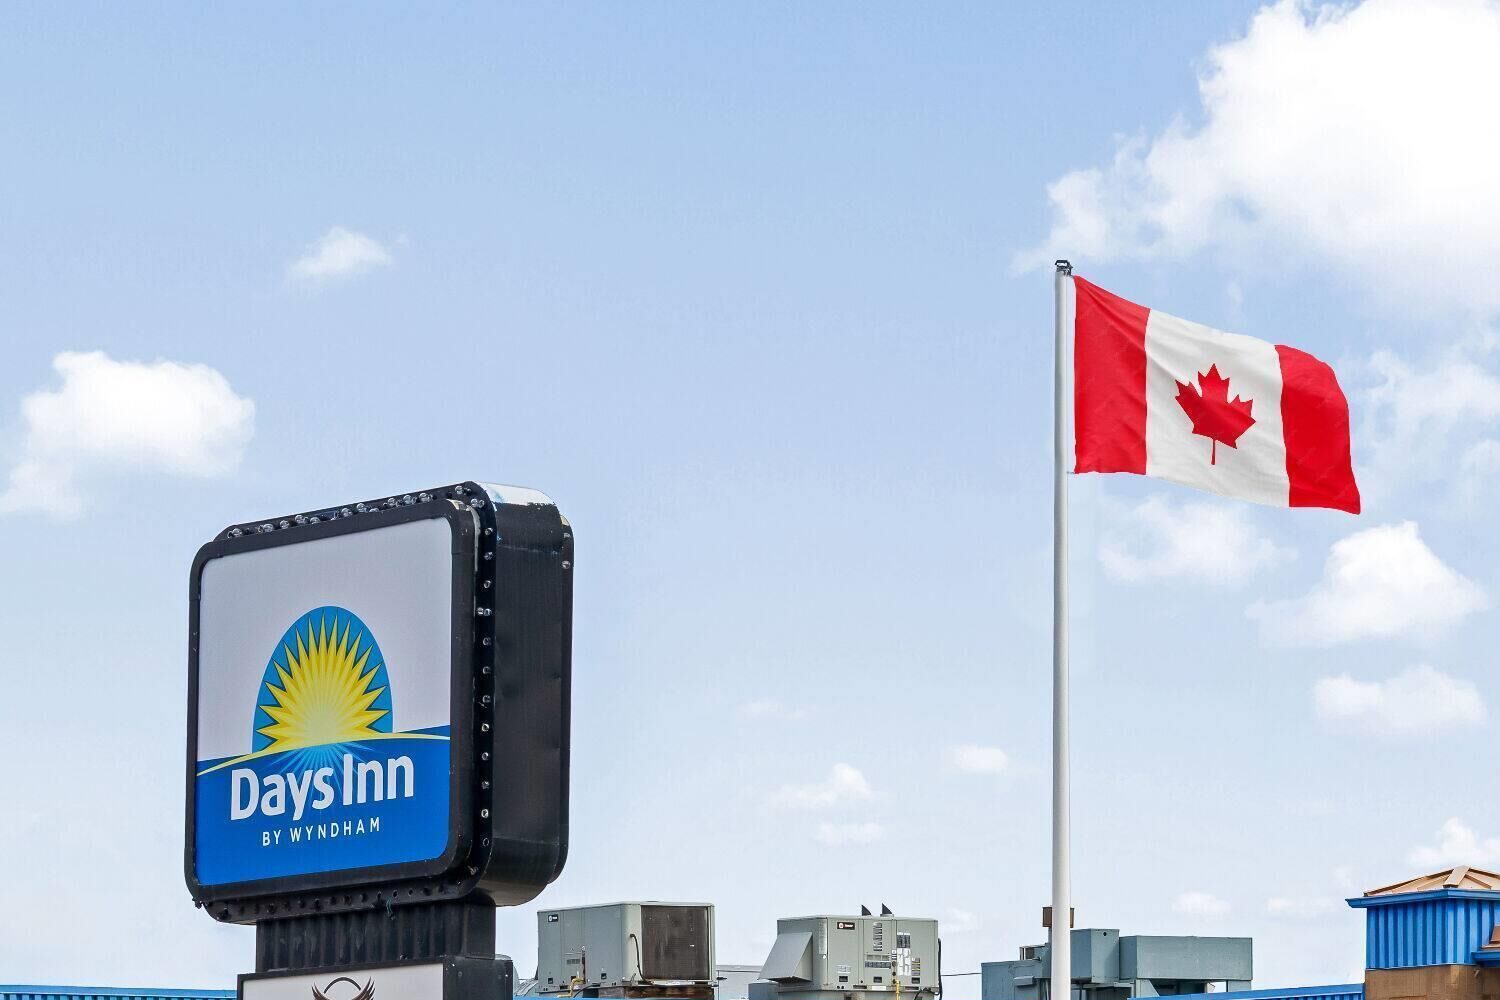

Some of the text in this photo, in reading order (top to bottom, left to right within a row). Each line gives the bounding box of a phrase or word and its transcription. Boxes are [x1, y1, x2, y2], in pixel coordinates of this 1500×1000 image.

[230, 754, 414, 821] Days Inn
[262, 816, 380, 847] BY WYNDHAM
